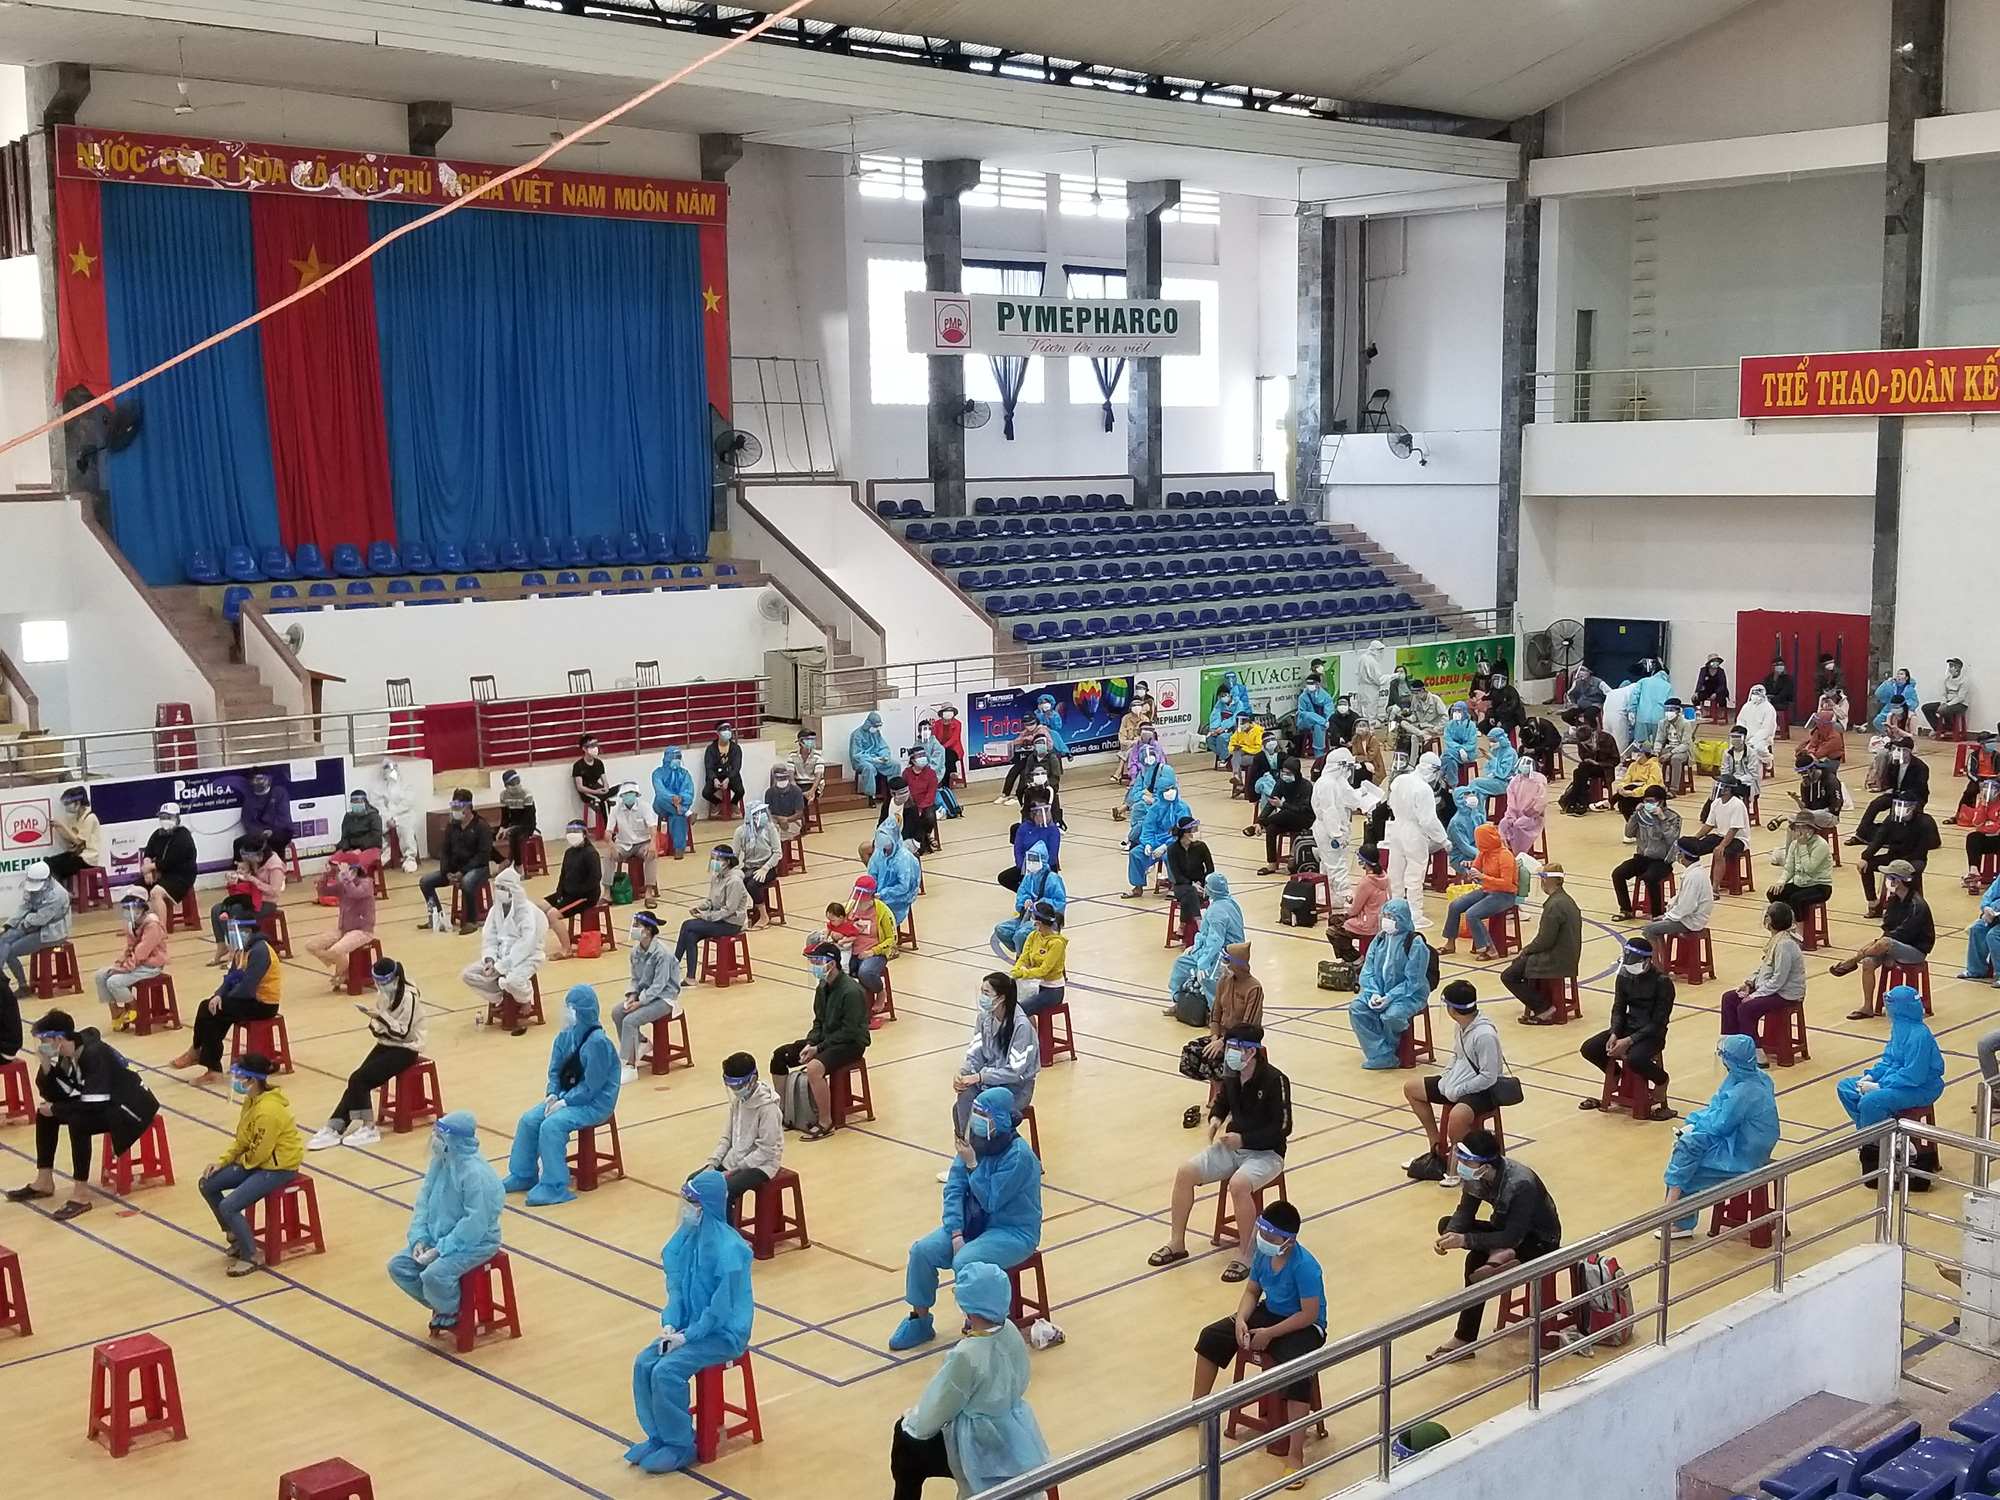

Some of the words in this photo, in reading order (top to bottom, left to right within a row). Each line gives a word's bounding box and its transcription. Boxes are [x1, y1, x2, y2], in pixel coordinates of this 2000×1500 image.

[238, 150, 287, 184] HÒA
[341, 157, 378, 196] HỘI
[389, 161, 432, 196] CHỦ
[440, 168, 505, 201] GHĨA
[511, 173, 554, 209] VIỆT
[563, 183, 606, 209] NAM
[614, 183, 668, 213] MUÔN
[676, 184, 716, 216] NĂM
[944, 317, 963, 331] PMP
[997, 301, 1178, 334] PYMEPHARCO
[1762, 356, 1809, 407] THỂ
[1815, 359, 1958, 406] THAO-ĐOÀN
[14, 818, 39, 833] PMP
